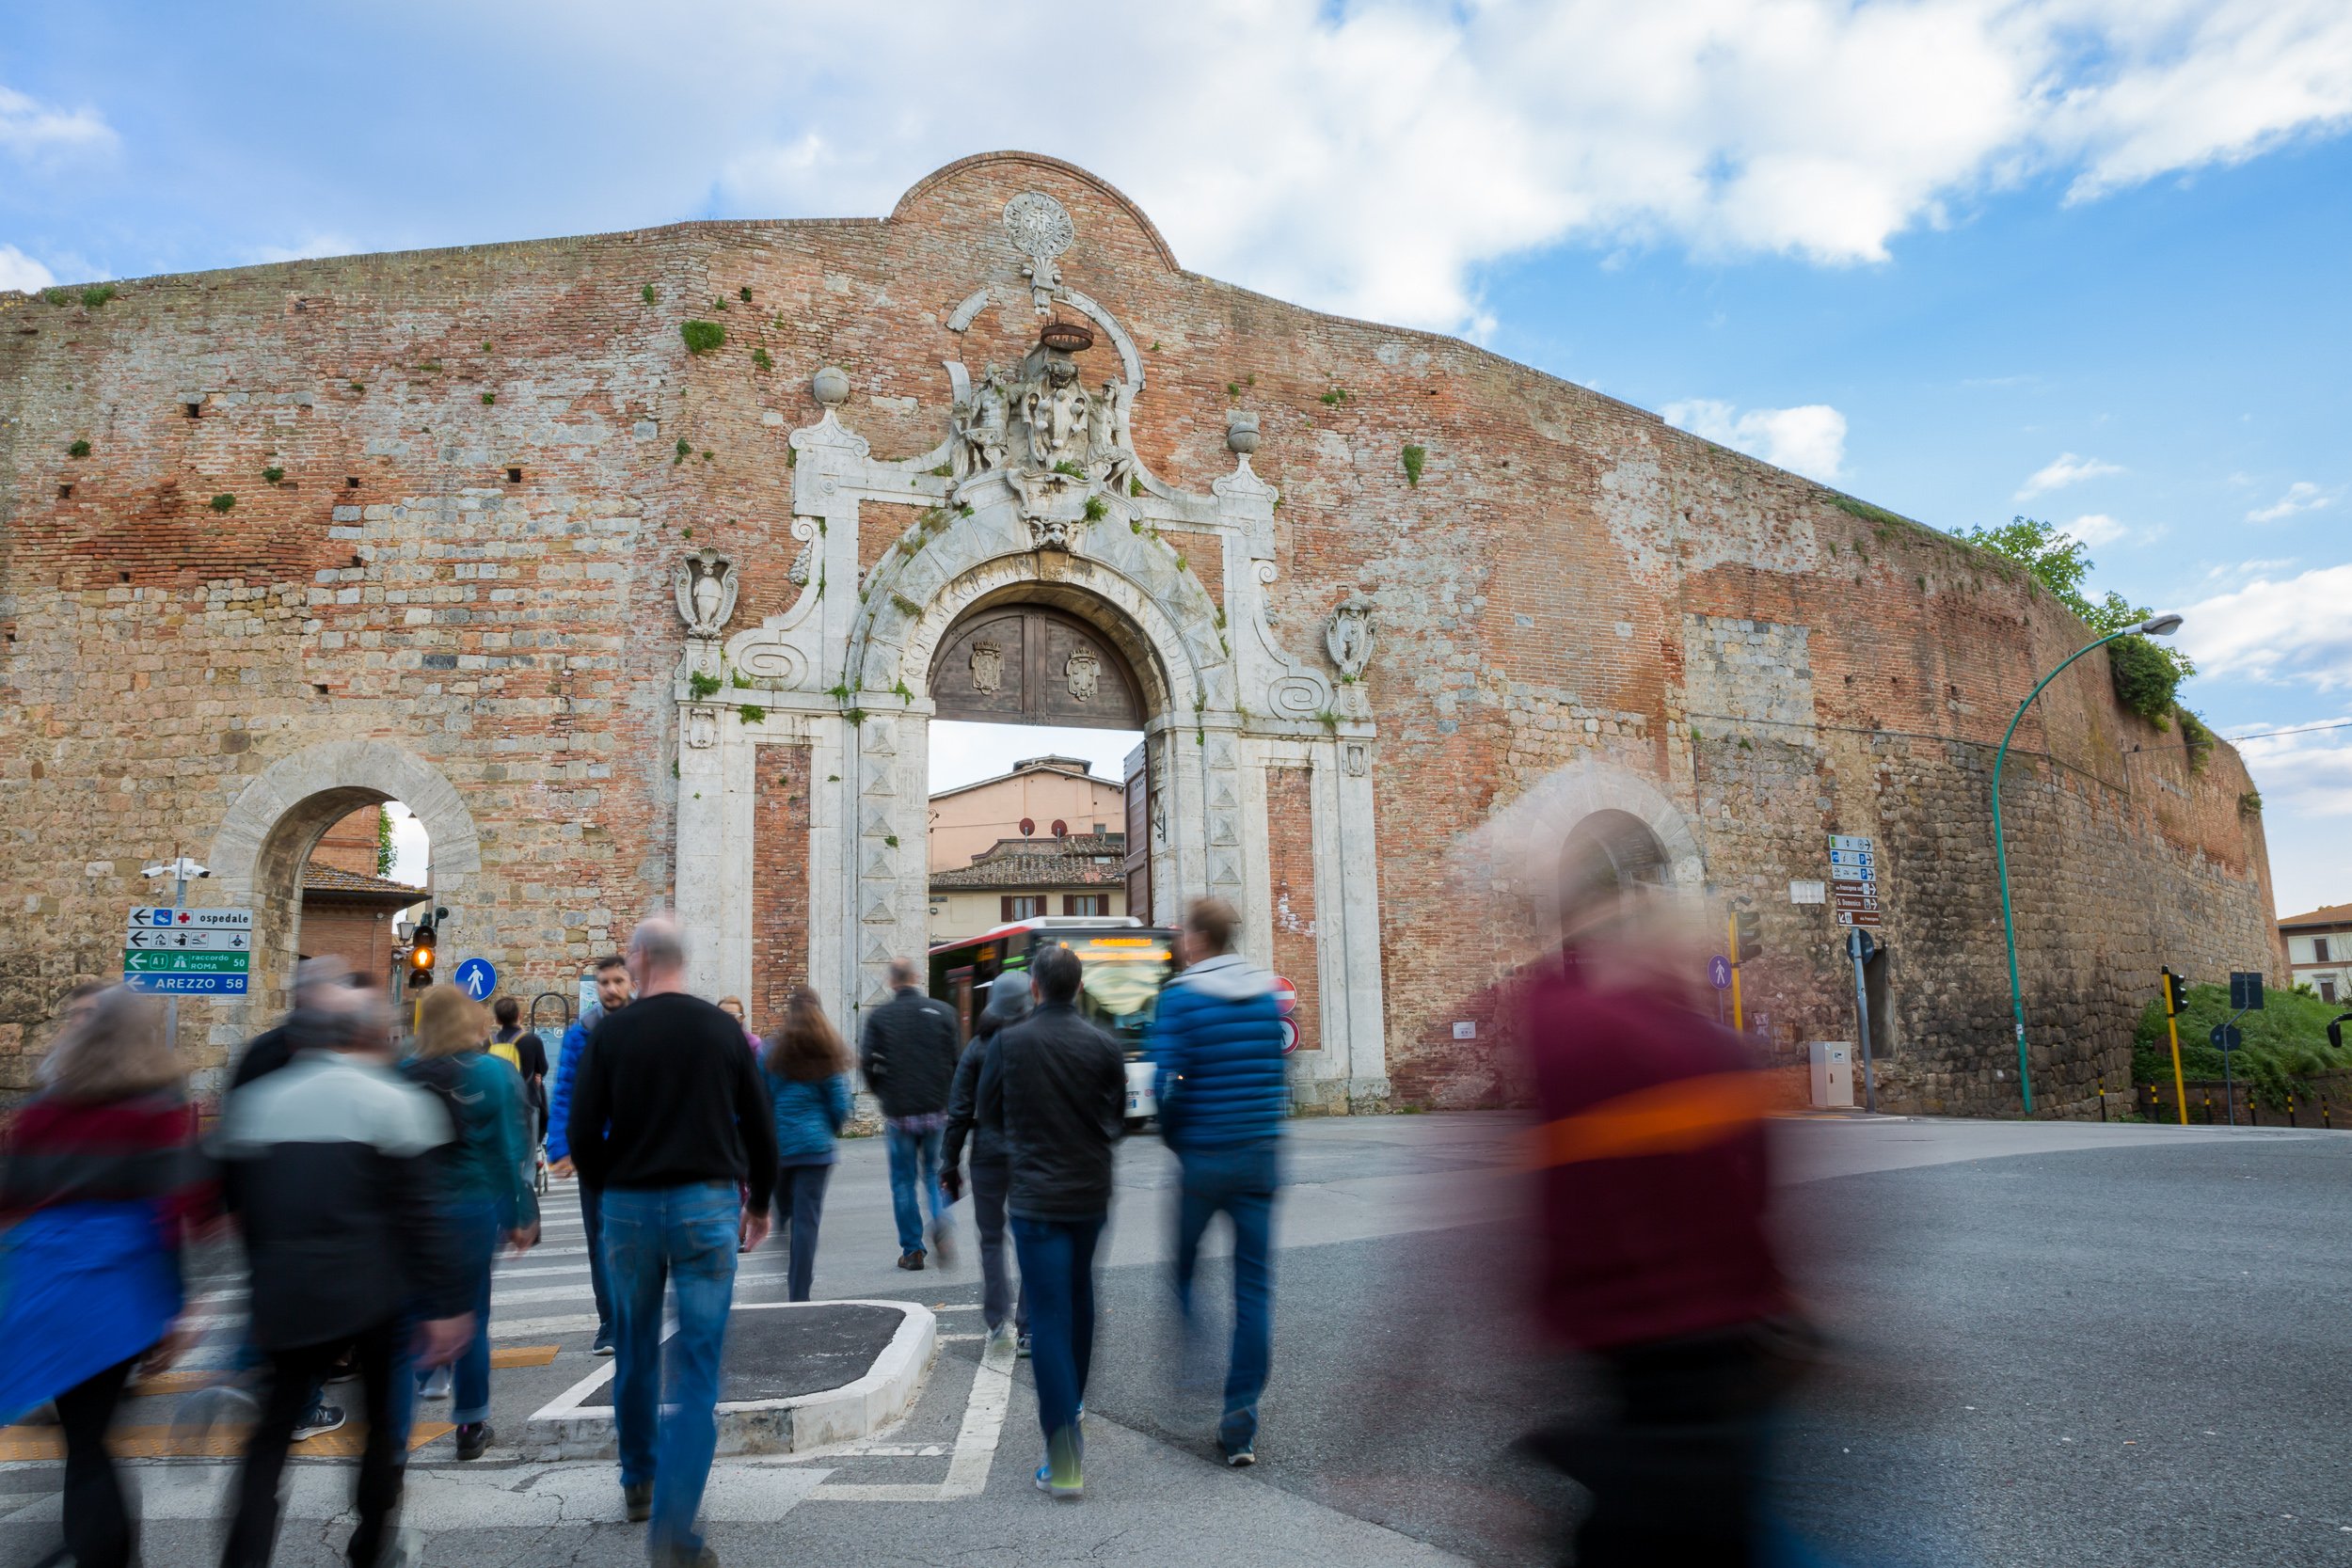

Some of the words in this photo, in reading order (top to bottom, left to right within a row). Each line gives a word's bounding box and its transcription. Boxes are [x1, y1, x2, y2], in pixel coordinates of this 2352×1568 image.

[1842, 898, 1861, 907] Domenico
[199, 913, 248, 924] ospedale
[233, 958, 246, 967] 50
[155, 978, 215, 989] AREZZO
[225, 978, 244, 990] 58
